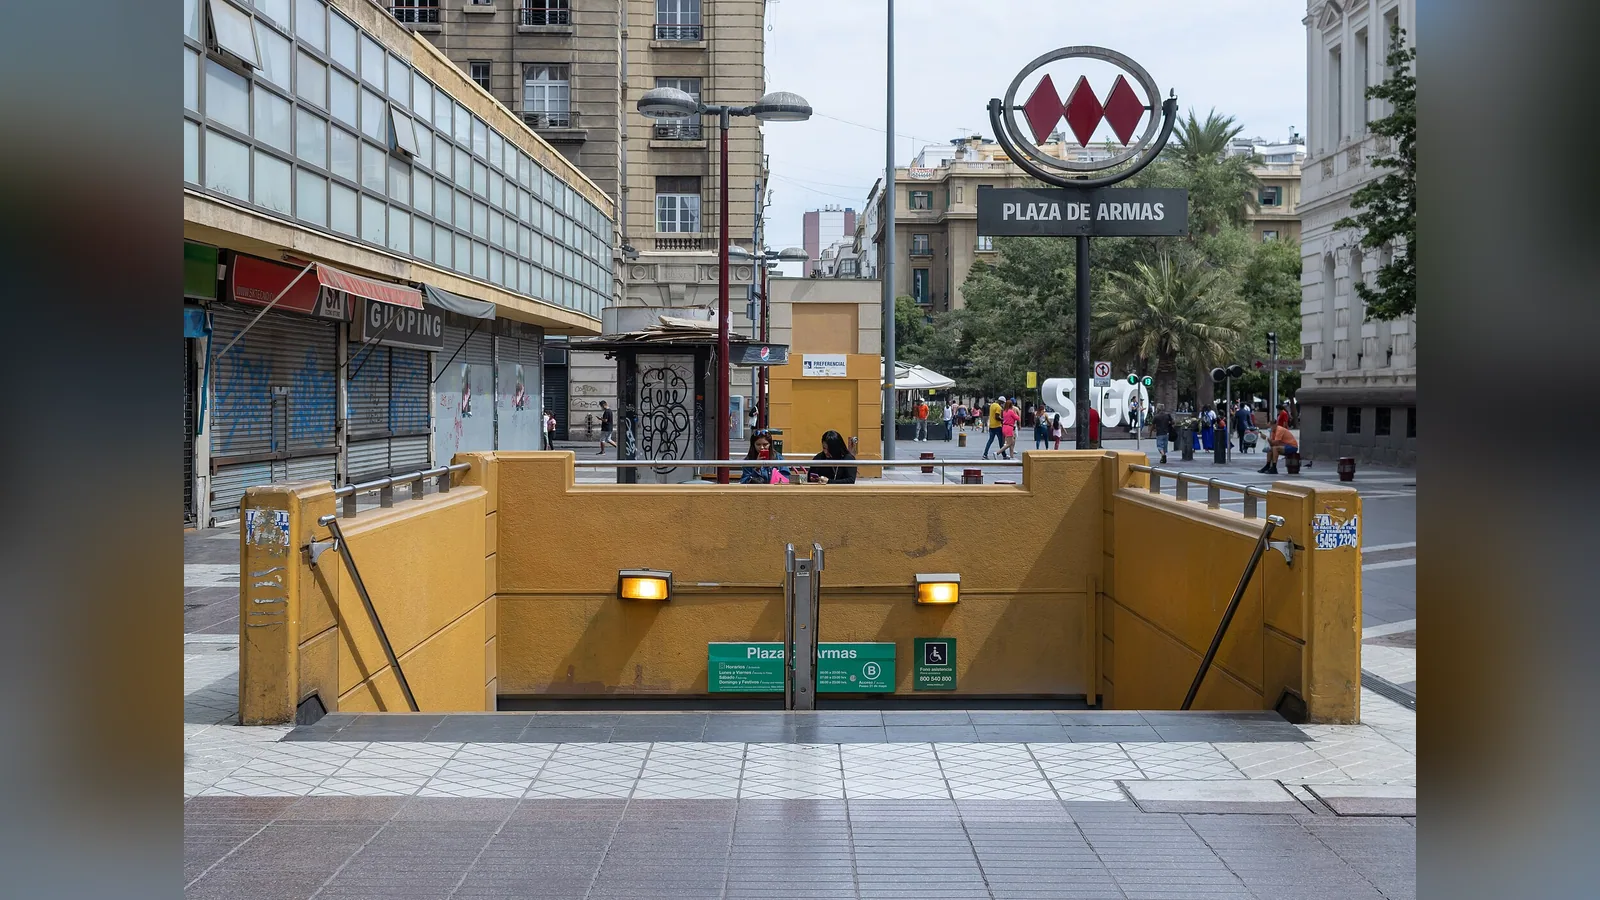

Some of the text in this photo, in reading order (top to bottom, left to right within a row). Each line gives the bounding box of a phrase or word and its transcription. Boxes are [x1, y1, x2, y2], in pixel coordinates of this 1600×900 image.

[1003, 202, 1165, 221] PLAZA DE ARMAS
[370, 302, 441, 338] GUOPING
[1320, 534, 1337, 548] 5455
[747, 647, 784, 658] Plaza
[868, 666, 876, 676] B
